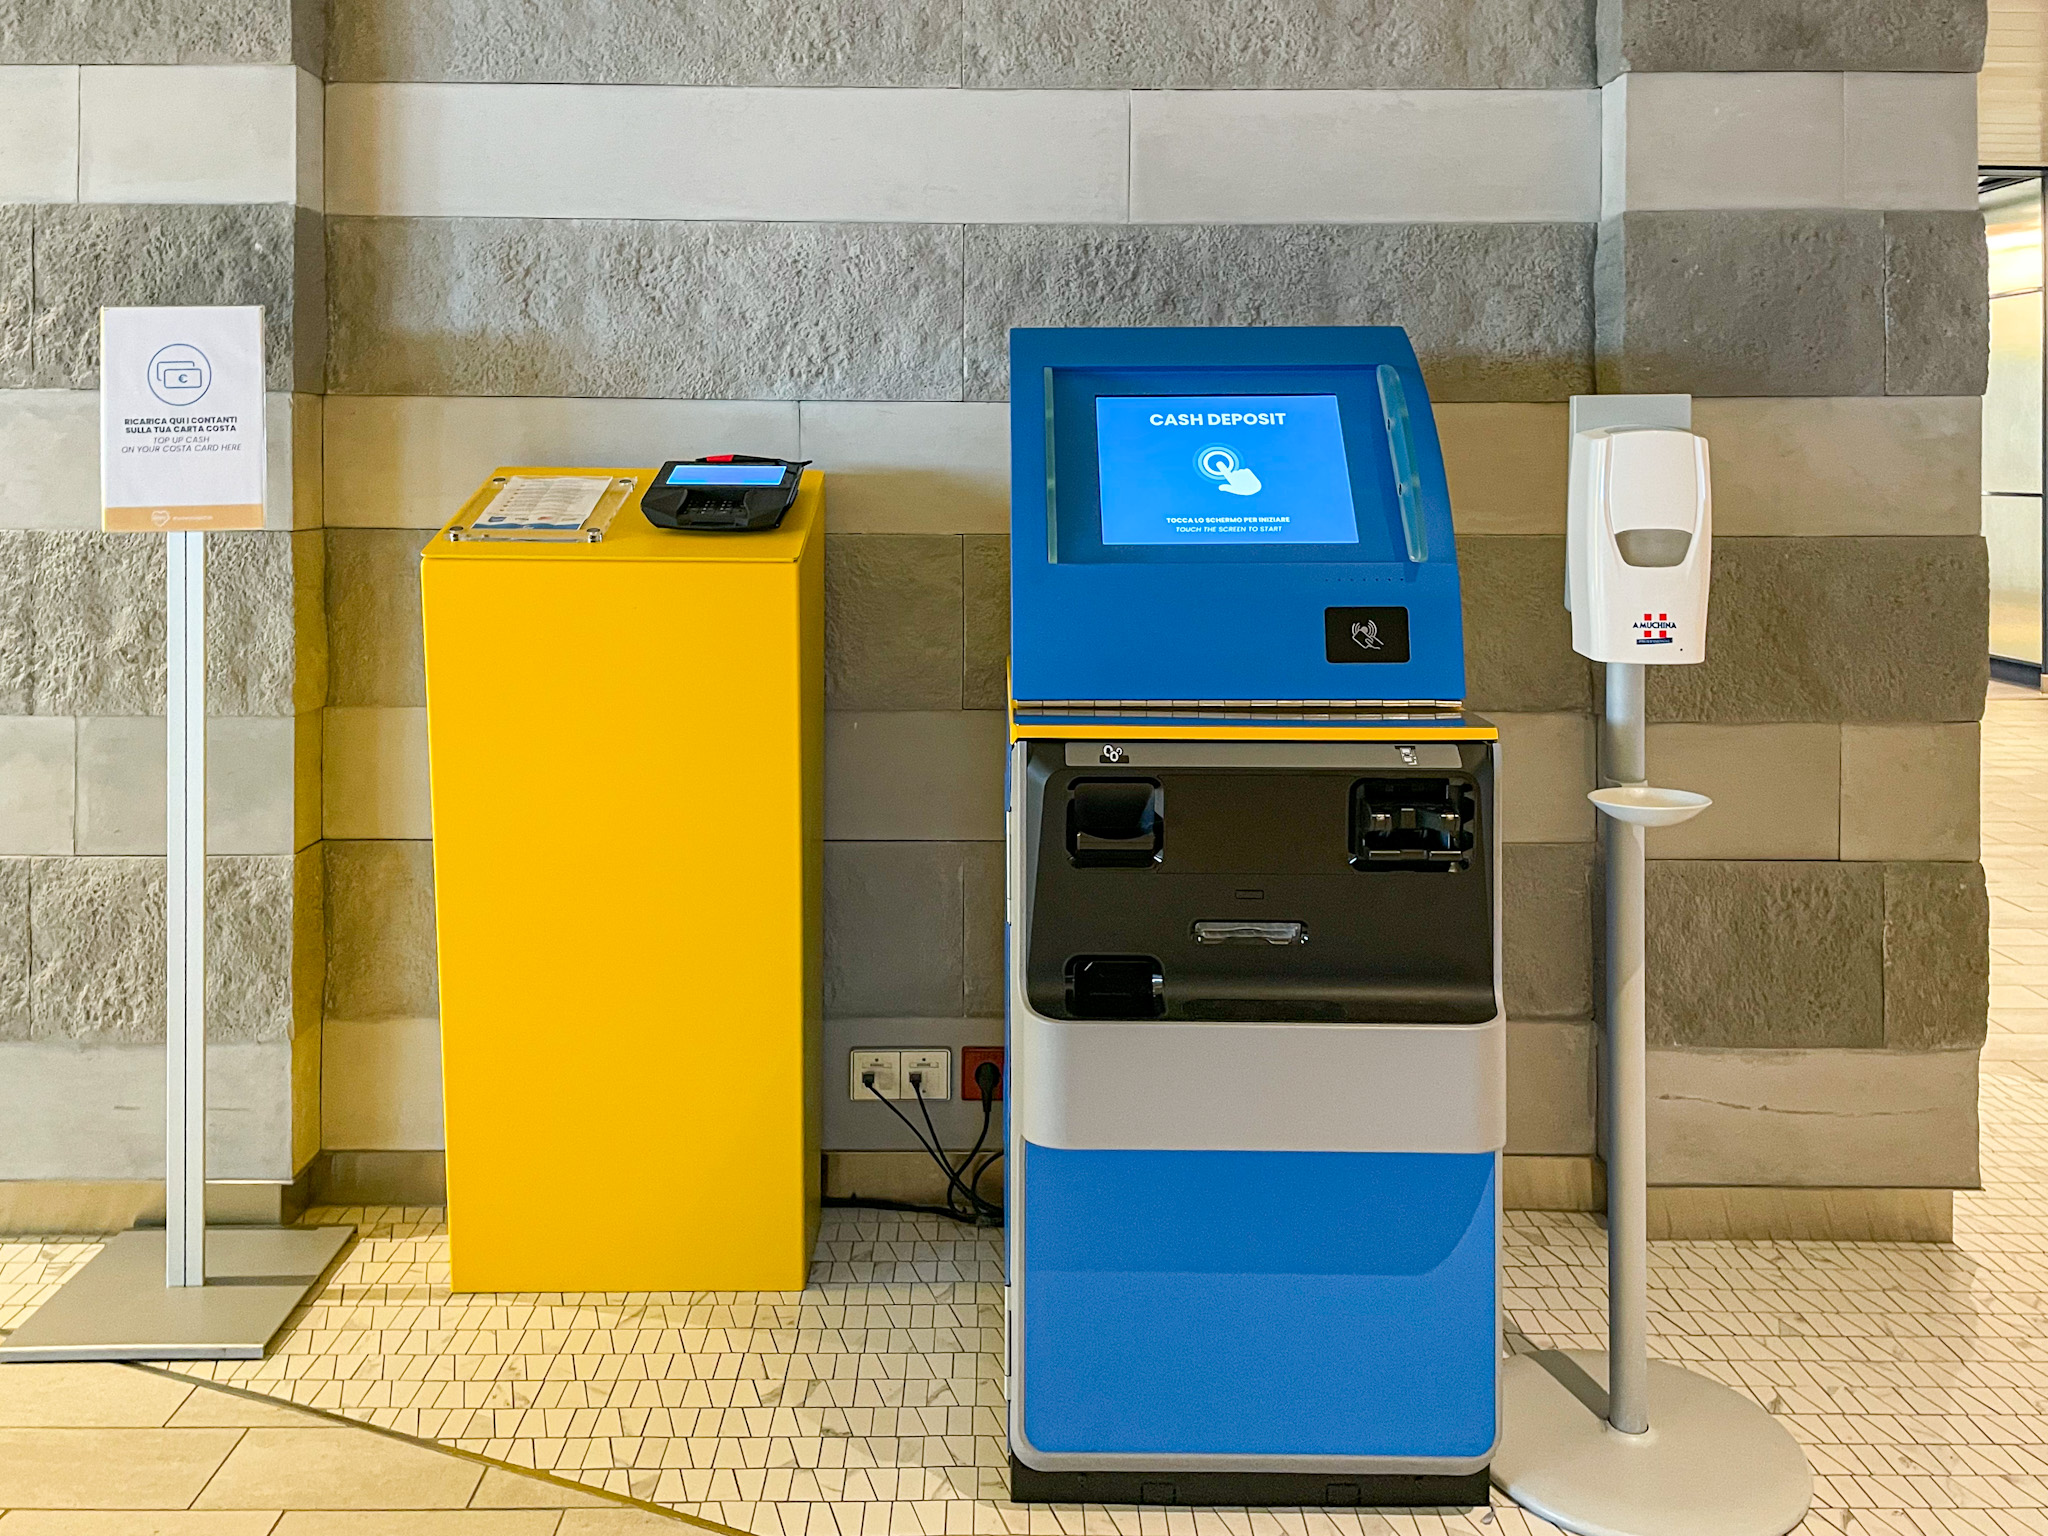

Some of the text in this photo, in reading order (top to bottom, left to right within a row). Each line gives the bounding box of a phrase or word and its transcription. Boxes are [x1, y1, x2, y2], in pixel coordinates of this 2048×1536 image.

[124, 417, 167, 425] RICARICA
[169, 417, 185, 425] QUI
[191, 416, 237, 424] CONTANTI
[1149, 412, 1287, 426] CASH DEPOSIT
[125, 426, 152, 434] SULLA
[173, 425, 204, 433] CARTA
[206, 424, 237, 432] COSTA
[172, 436, 184, 444] UP
[185, 436, 210, 444] CASH
[137, 445, 160, 453] YOUR
[162, 444, 192, 452] COSTA
[194, 444, 219, 452] CARD
[221, 443, 241, 451] HERE
